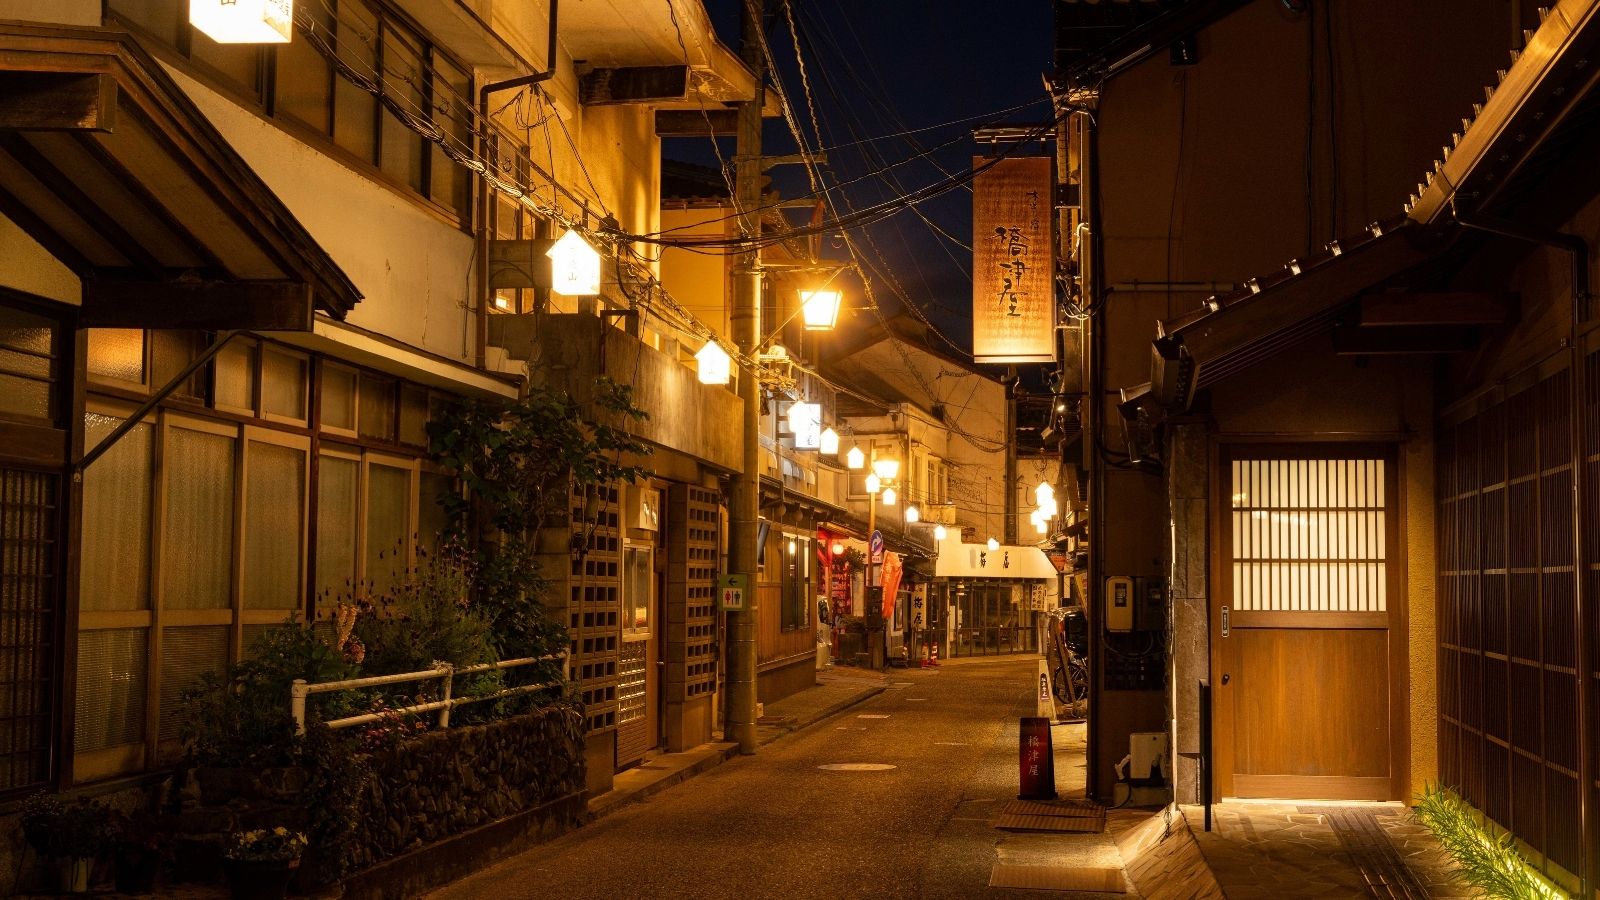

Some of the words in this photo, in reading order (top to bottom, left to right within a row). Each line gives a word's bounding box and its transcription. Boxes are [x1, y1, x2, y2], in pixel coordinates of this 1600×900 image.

[984, 225, 1031, 317] 橋津屋
[1028, 735, 1040, 776] 橋津屋
